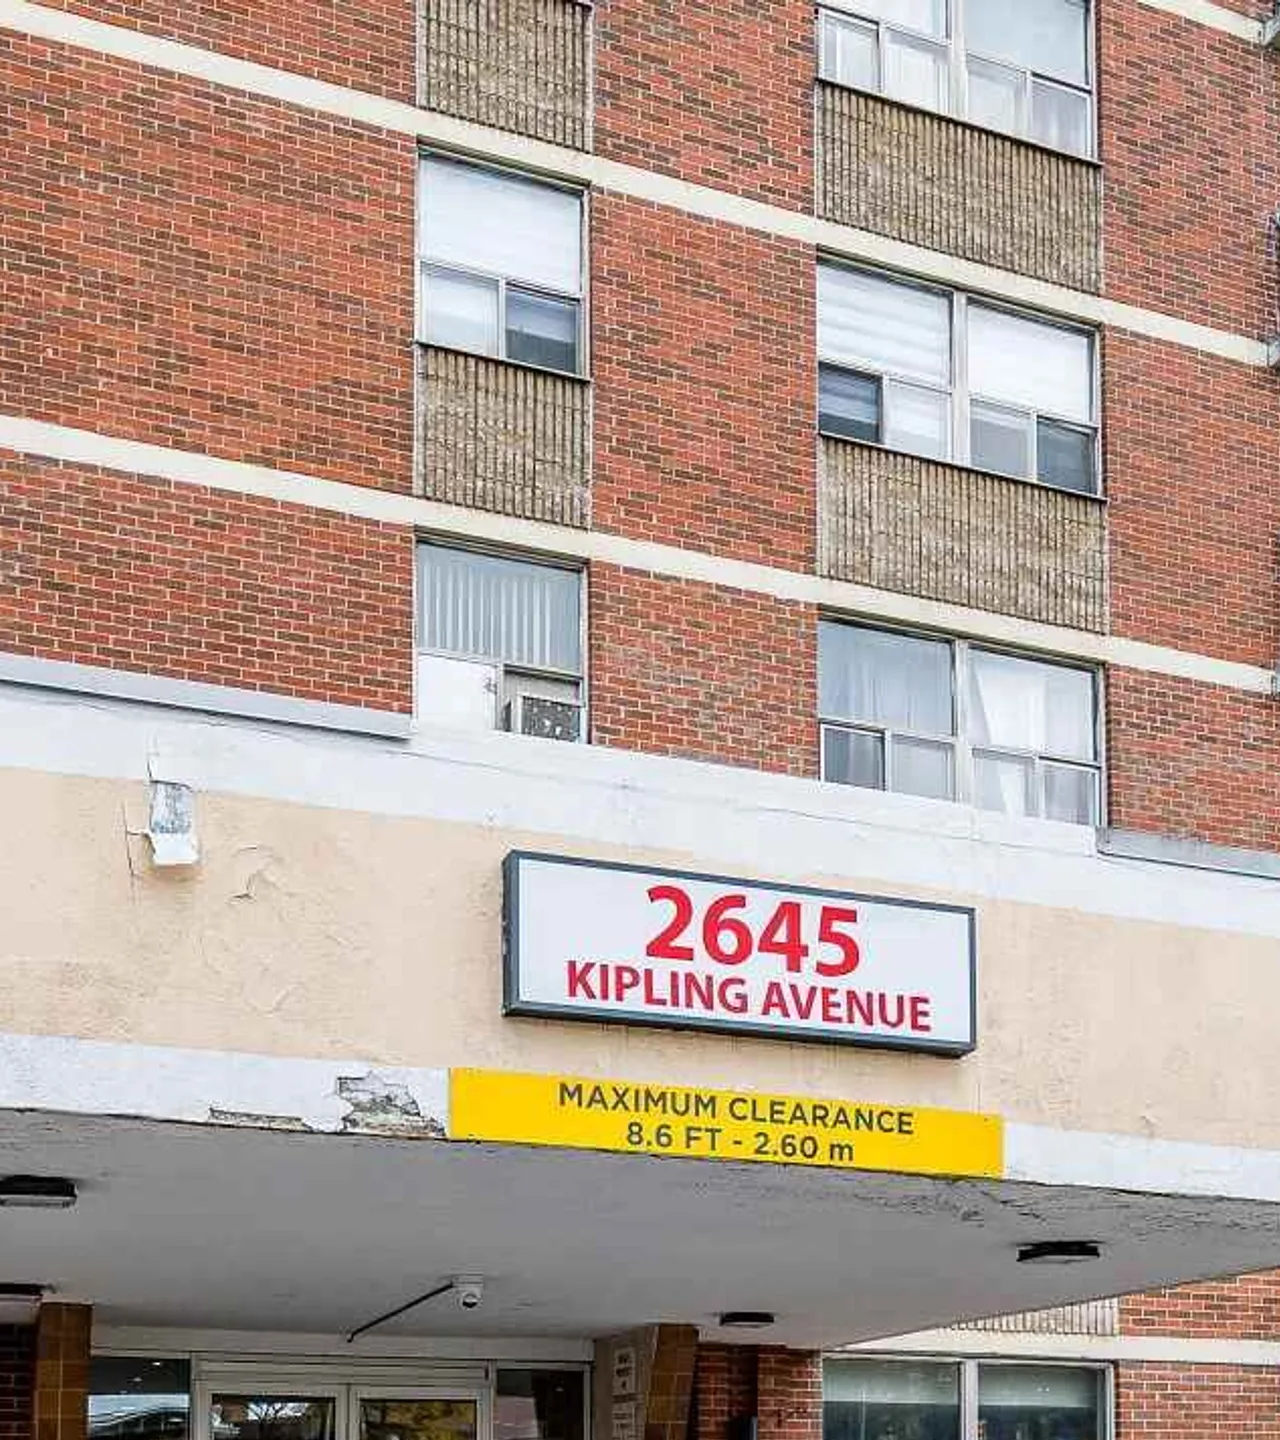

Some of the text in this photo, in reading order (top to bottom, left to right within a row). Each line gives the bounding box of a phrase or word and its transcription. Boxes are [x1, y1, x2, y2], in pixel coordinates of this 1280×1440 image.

[646, 885, 860, 977] 2645
[567, 961, 932, 1032] KIPLING AVENUE
[559, 1082, 915, 1135] MAXIMUM CLEARANCE
[626, 1123, 671, 1150] 8.6
[685, 1126, 722, 1152] FT
[753, 1132, 818, 1160] 2.60
[829, 1140, 854, 1162] m
